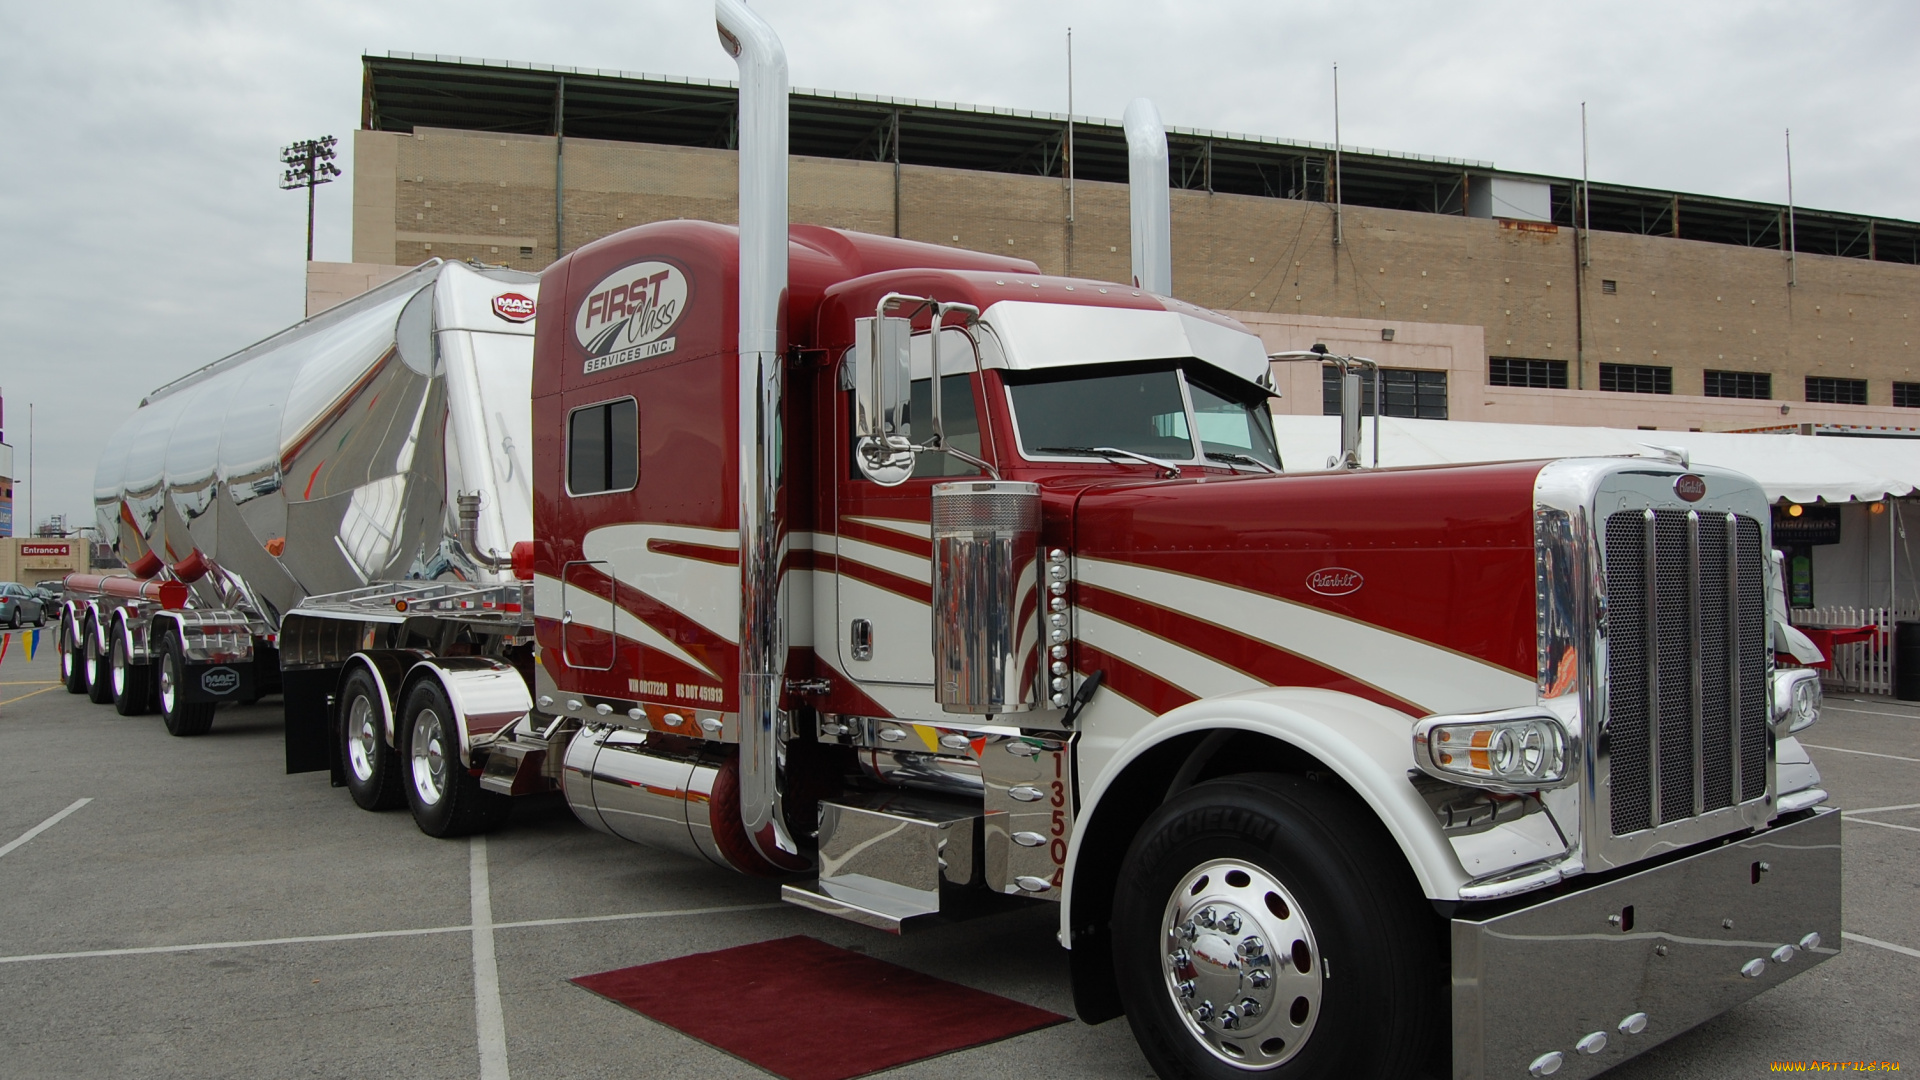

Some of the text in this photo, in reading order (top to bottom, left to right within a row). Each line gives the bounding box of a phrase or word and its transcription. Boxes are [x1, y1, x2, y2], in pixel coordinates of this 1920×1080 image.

[498, 297, 532, 309] MAC
[586, 270, 669, 329] FIRST
[628, 297, 675, 343] Class
[587, 340, 672, 371] SERVICES INC.
[23, 546, 67, 554] Entrance 4
[1312, 572, 1357, 589] Peterbilt
[205, 674, 236, 683] MAC
[628, 678, 639, 692] VIN
[676, 683, 685, 698] US
[685, 684, 699, 699] DOT
